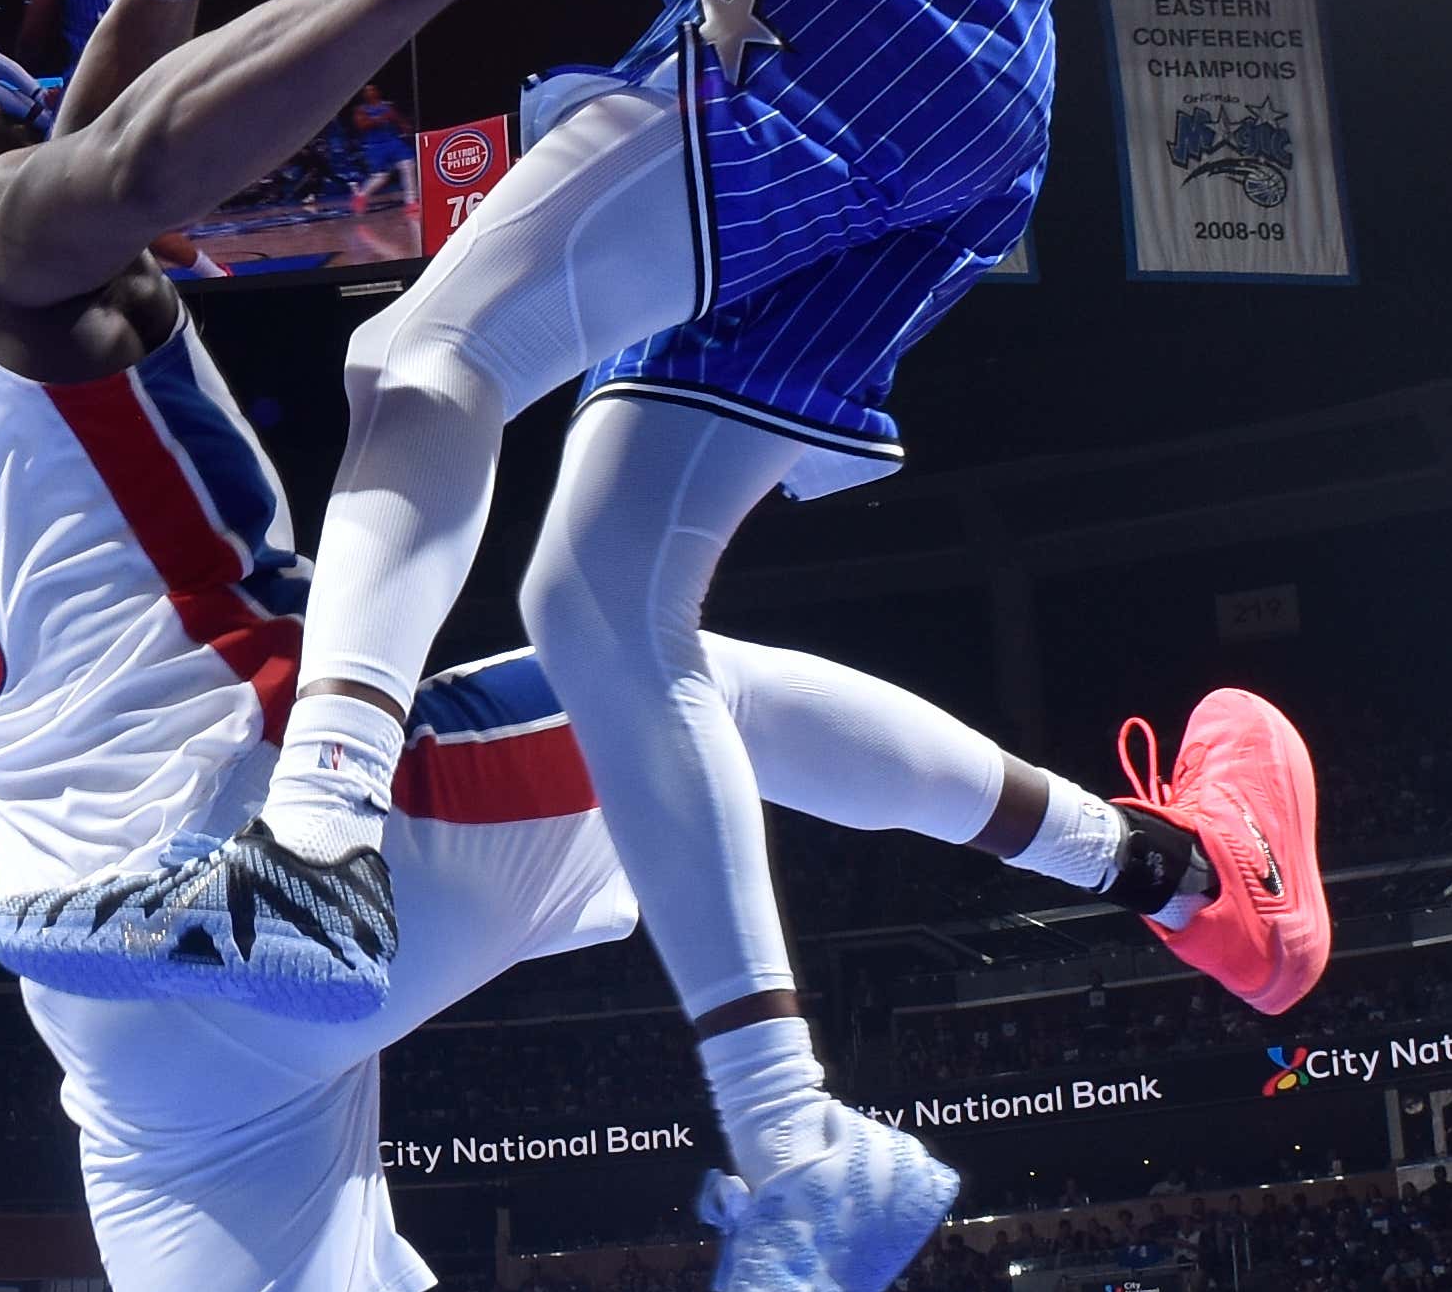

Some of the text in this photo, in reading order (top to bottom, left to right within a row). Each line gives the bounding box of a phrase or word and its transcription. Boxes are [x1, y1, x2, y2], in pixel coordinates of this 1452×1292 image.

[1133, 28, 1304, 48] CONFERENCE
[1148, 59, 1296, 80] CHAMPIONS
[1195, 221, 1285, 241] 2008-09
[1306, 1047, 1381, 1082] City
[914, 1074, 1162, 1127] National Bank
[378, 1124, 693, 1173] City National Bank
